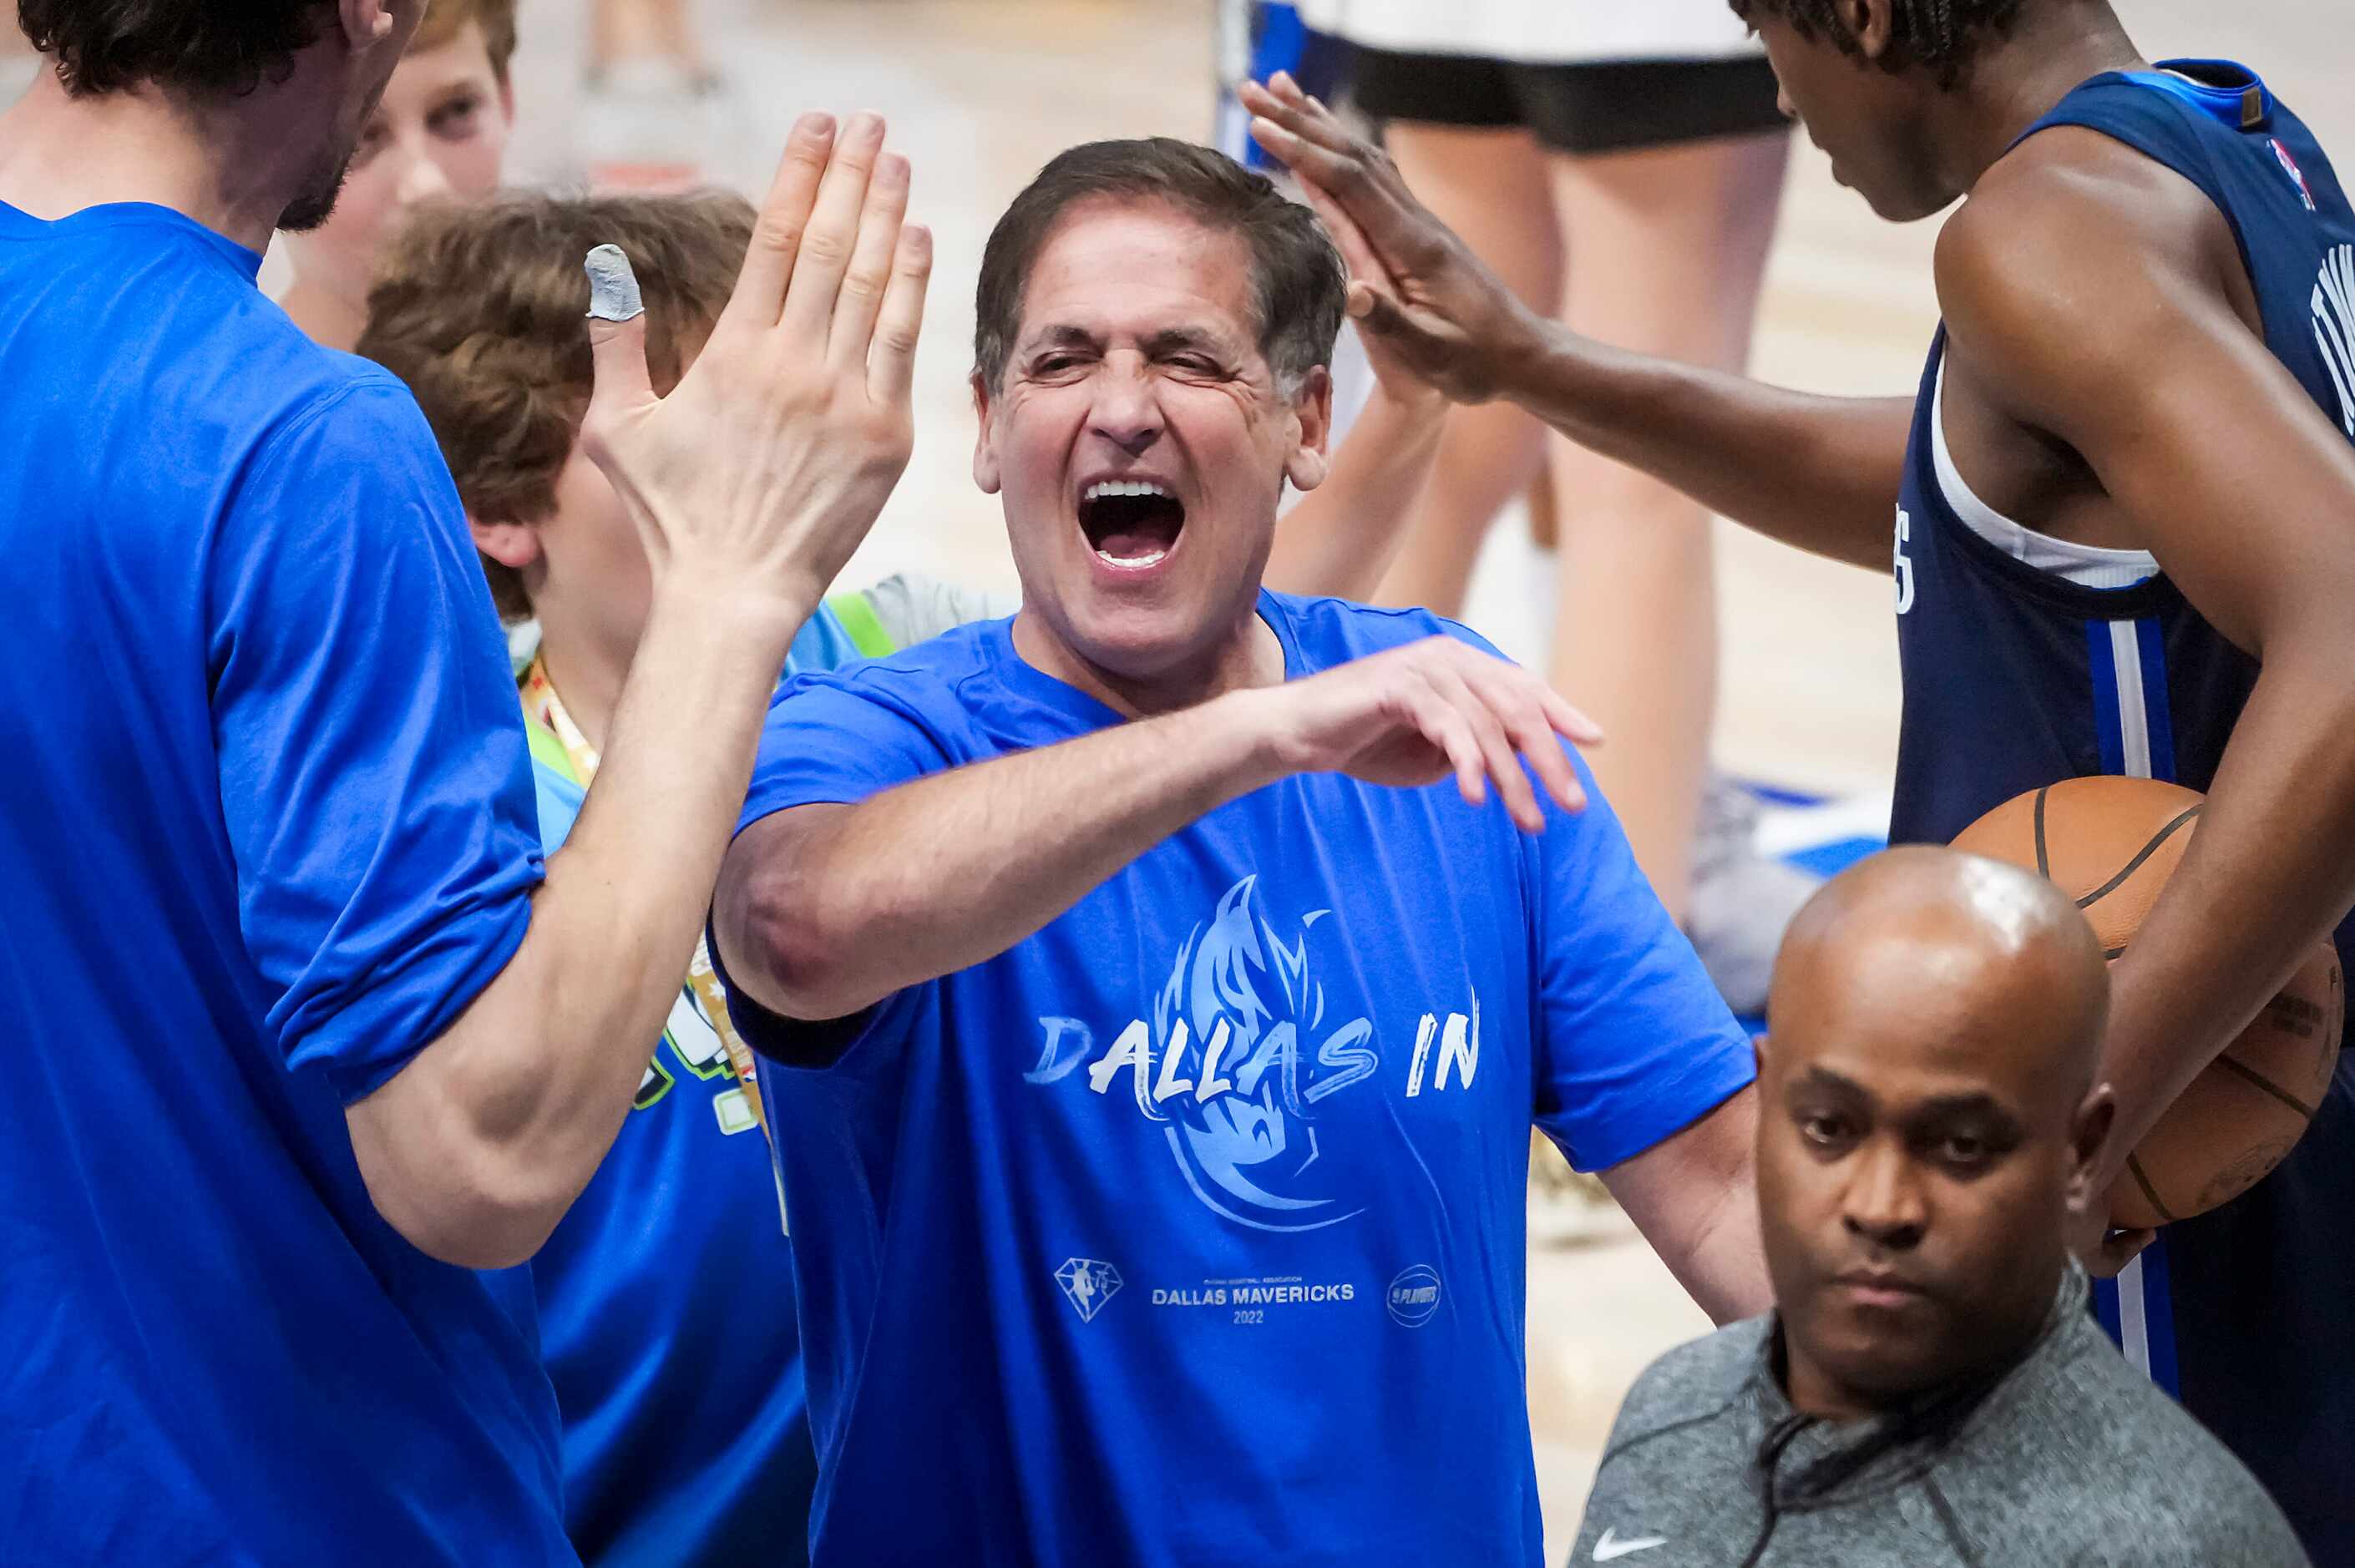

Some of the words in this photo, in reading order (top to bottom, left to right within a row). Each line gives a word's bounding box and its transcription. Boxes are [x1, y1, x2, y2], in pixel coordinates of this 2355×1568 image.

[1022, 1015, 1379, 1121] DALLAS
[1406, 984, 1480, 1098] IN
[1152, 1288, 1227, 1305] DALLAS
[1233, 1284, 1355, 1304] MAVERICKS
[1233, 1309, 1264, 1324] 2022
